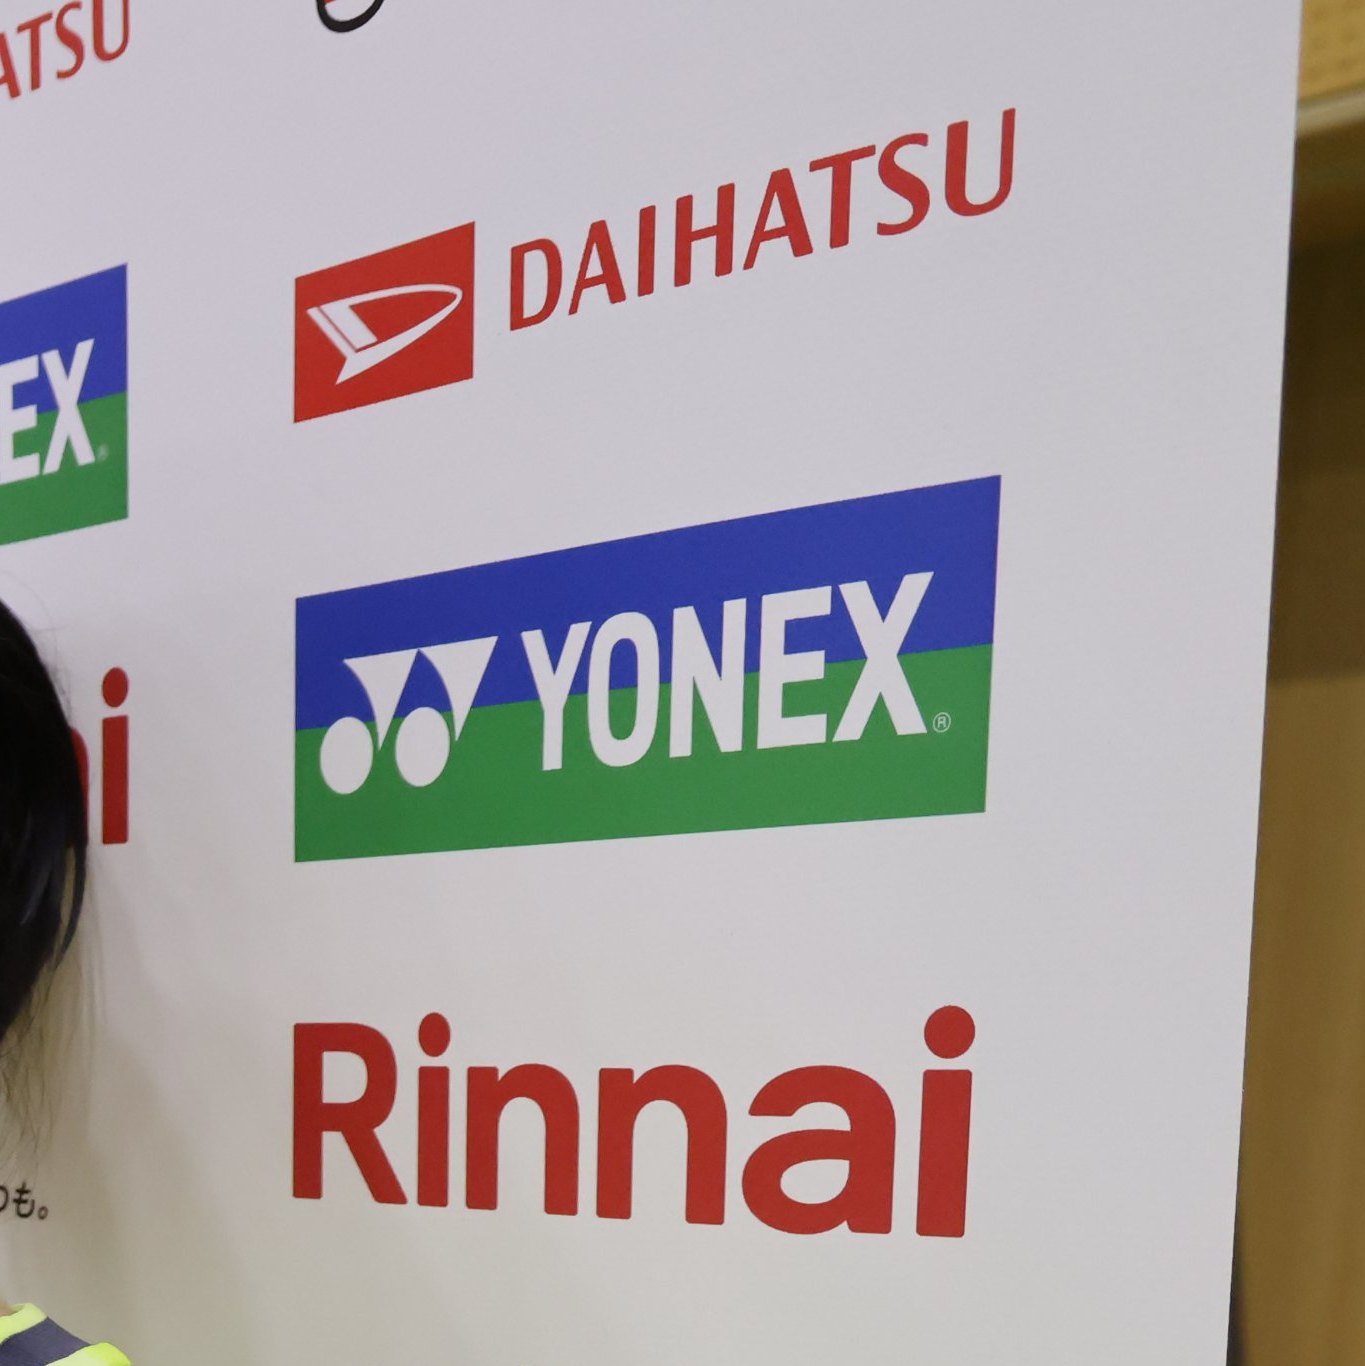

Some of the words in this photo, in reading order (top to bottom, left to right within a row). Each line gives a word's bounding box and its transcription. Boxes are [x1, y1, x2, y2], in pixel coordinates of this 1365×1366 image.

[508, 108, 1016, 331] DAIHATSU
[521, 571, 934, 772] YONEX
[292, 1004, 976, 1238] Rinnai
